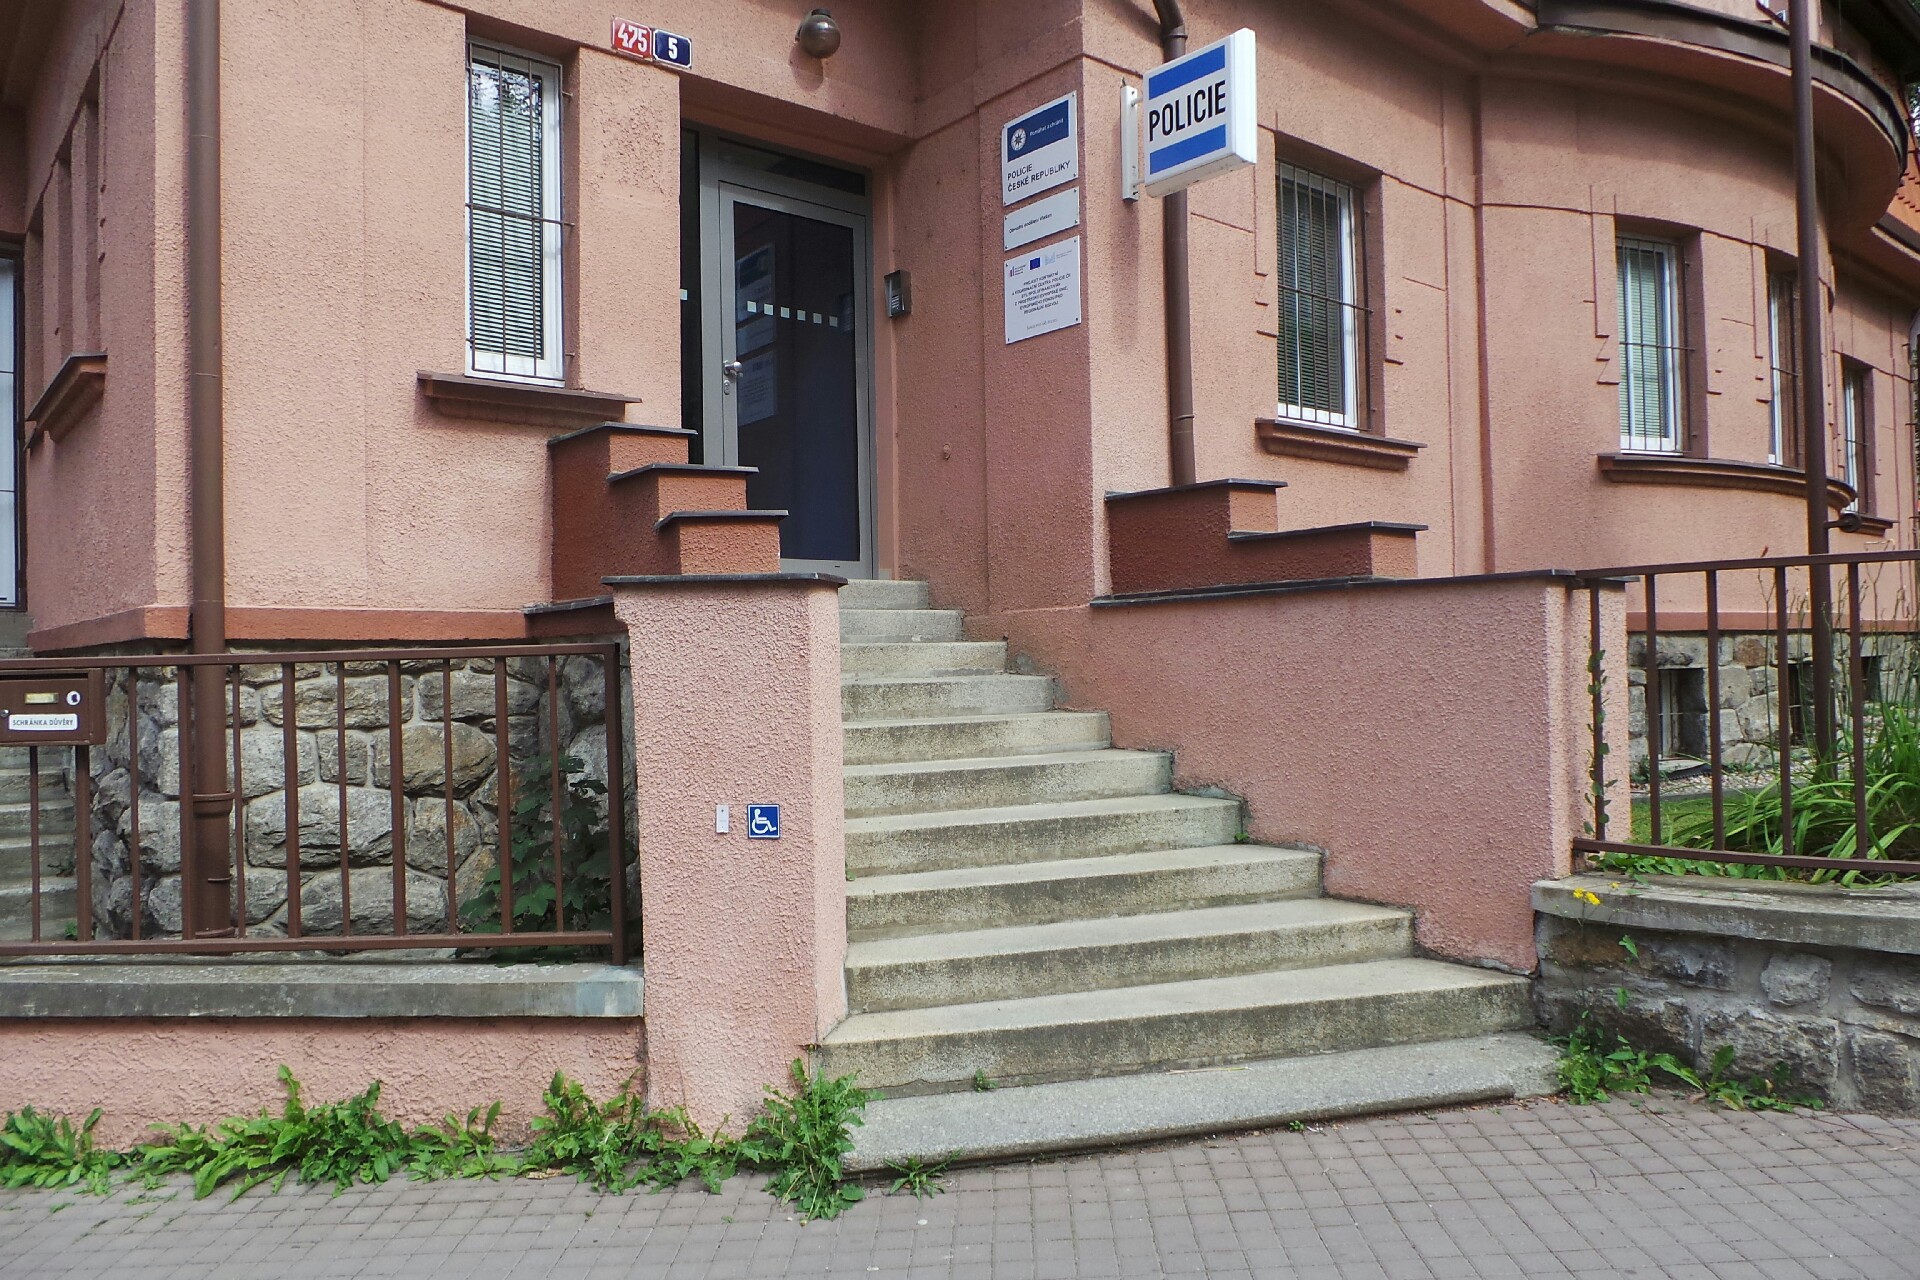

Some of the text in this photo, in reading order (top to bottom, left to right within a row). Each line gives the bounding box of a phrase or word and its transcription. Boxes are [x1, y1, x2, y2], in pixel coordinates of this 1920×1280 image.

[617, 23, 648, 53] 475
[668, 36, 678, 60] 5
[1149, 80, 1226, 142] POLICIE
[1007, 163, 1033, 181] POLICIE
[1007, 160, 1071, 192] ČESKÉ REPUBLIKY
[12, 717, 74, 726] SCHRÁNKA DŮVĚRY
